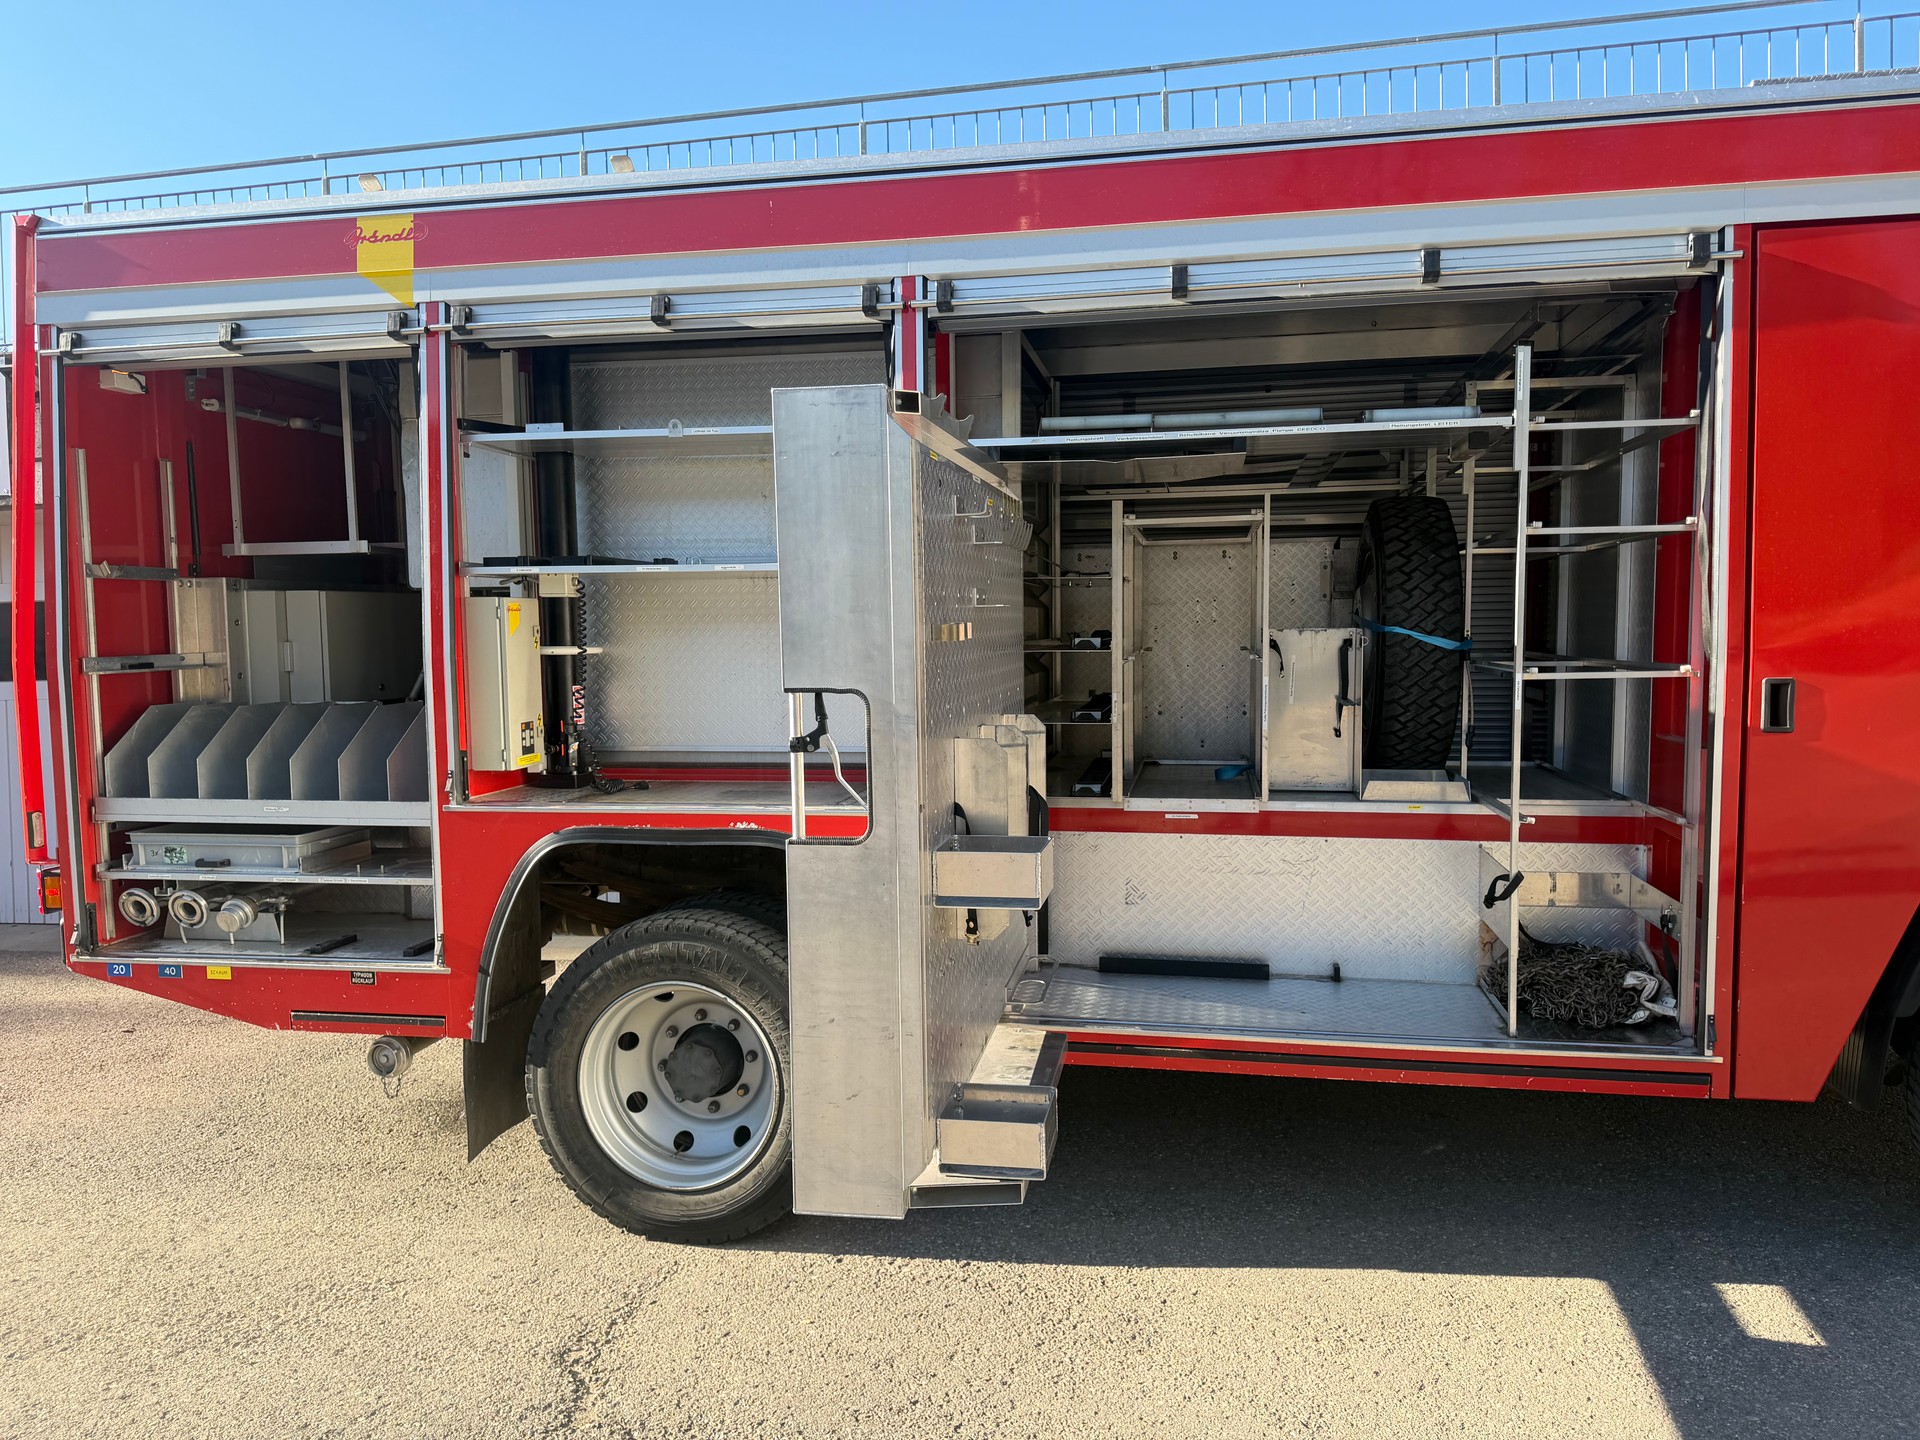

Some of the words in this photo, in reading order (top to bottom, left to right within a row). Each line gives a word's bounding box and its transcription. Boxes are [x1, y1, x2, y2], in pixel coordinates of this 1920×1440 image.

[150, 849, 159, 857] 3x
[113, 964, 126, 975] 20
[164, 966, 176, 976] 40
